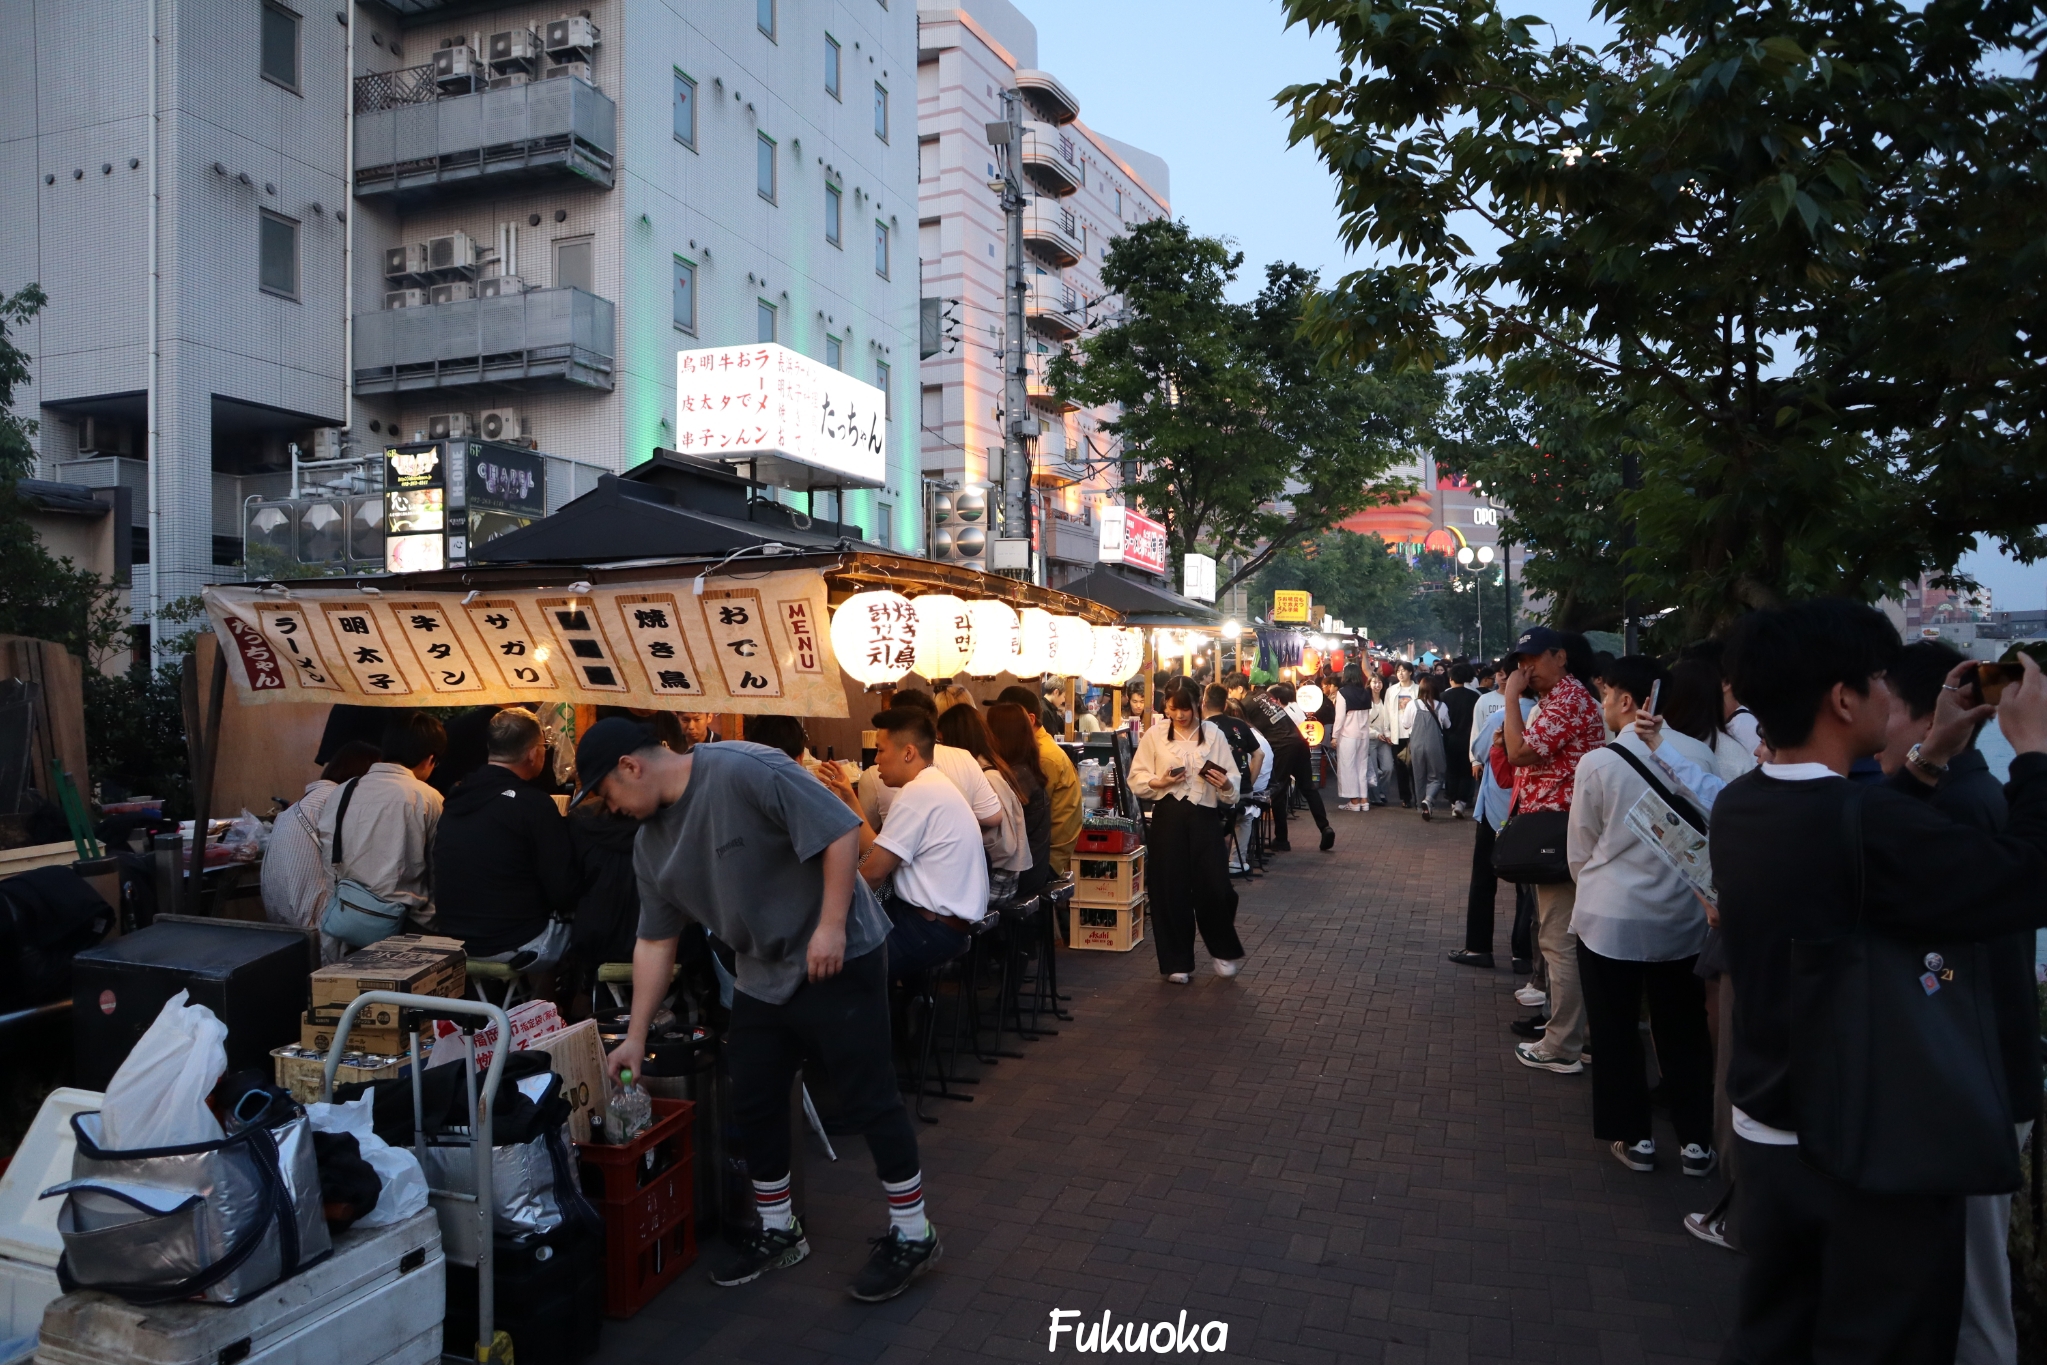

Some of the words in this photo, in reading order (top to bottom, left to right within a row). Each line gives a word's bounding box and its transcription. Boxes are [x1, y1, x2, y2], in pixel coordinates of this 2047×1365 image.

[699, 354, 714, 447] 明太子
[718, 353, 734, 447] 牛タン
[736, 352, 752, 446] おでん
[754, 349, 770, 444] ラーメン
[821, 392, 883, 455] たっちゃん
[452, 450, 463, 497] H-ONE
[469, 443, 482, 456] 6F
[231, 618, 280, 688] たっちゃん
[275, 617, 326, 683] ラーメン
[338, 616, 396, 689] 明太子
[410, 614, 466, 685] 牛タン
[484, 613, 540, 683] サガリ
[634, 609, 691, 690] 焼き鳥
[719, 606, 768, 688] おでん
[788, 604, 815, 669] MENU
[866, 602, 895, 667] 닭꼬치
[893, 599, 920, 671] 焼き鳥
[955, 614, 974, 653] 라면
[1048, 621, 1060, 659] 오뎅
[1089, 930, 1109, 940] Asahi
[1940, 968, 1954, 982] 21
